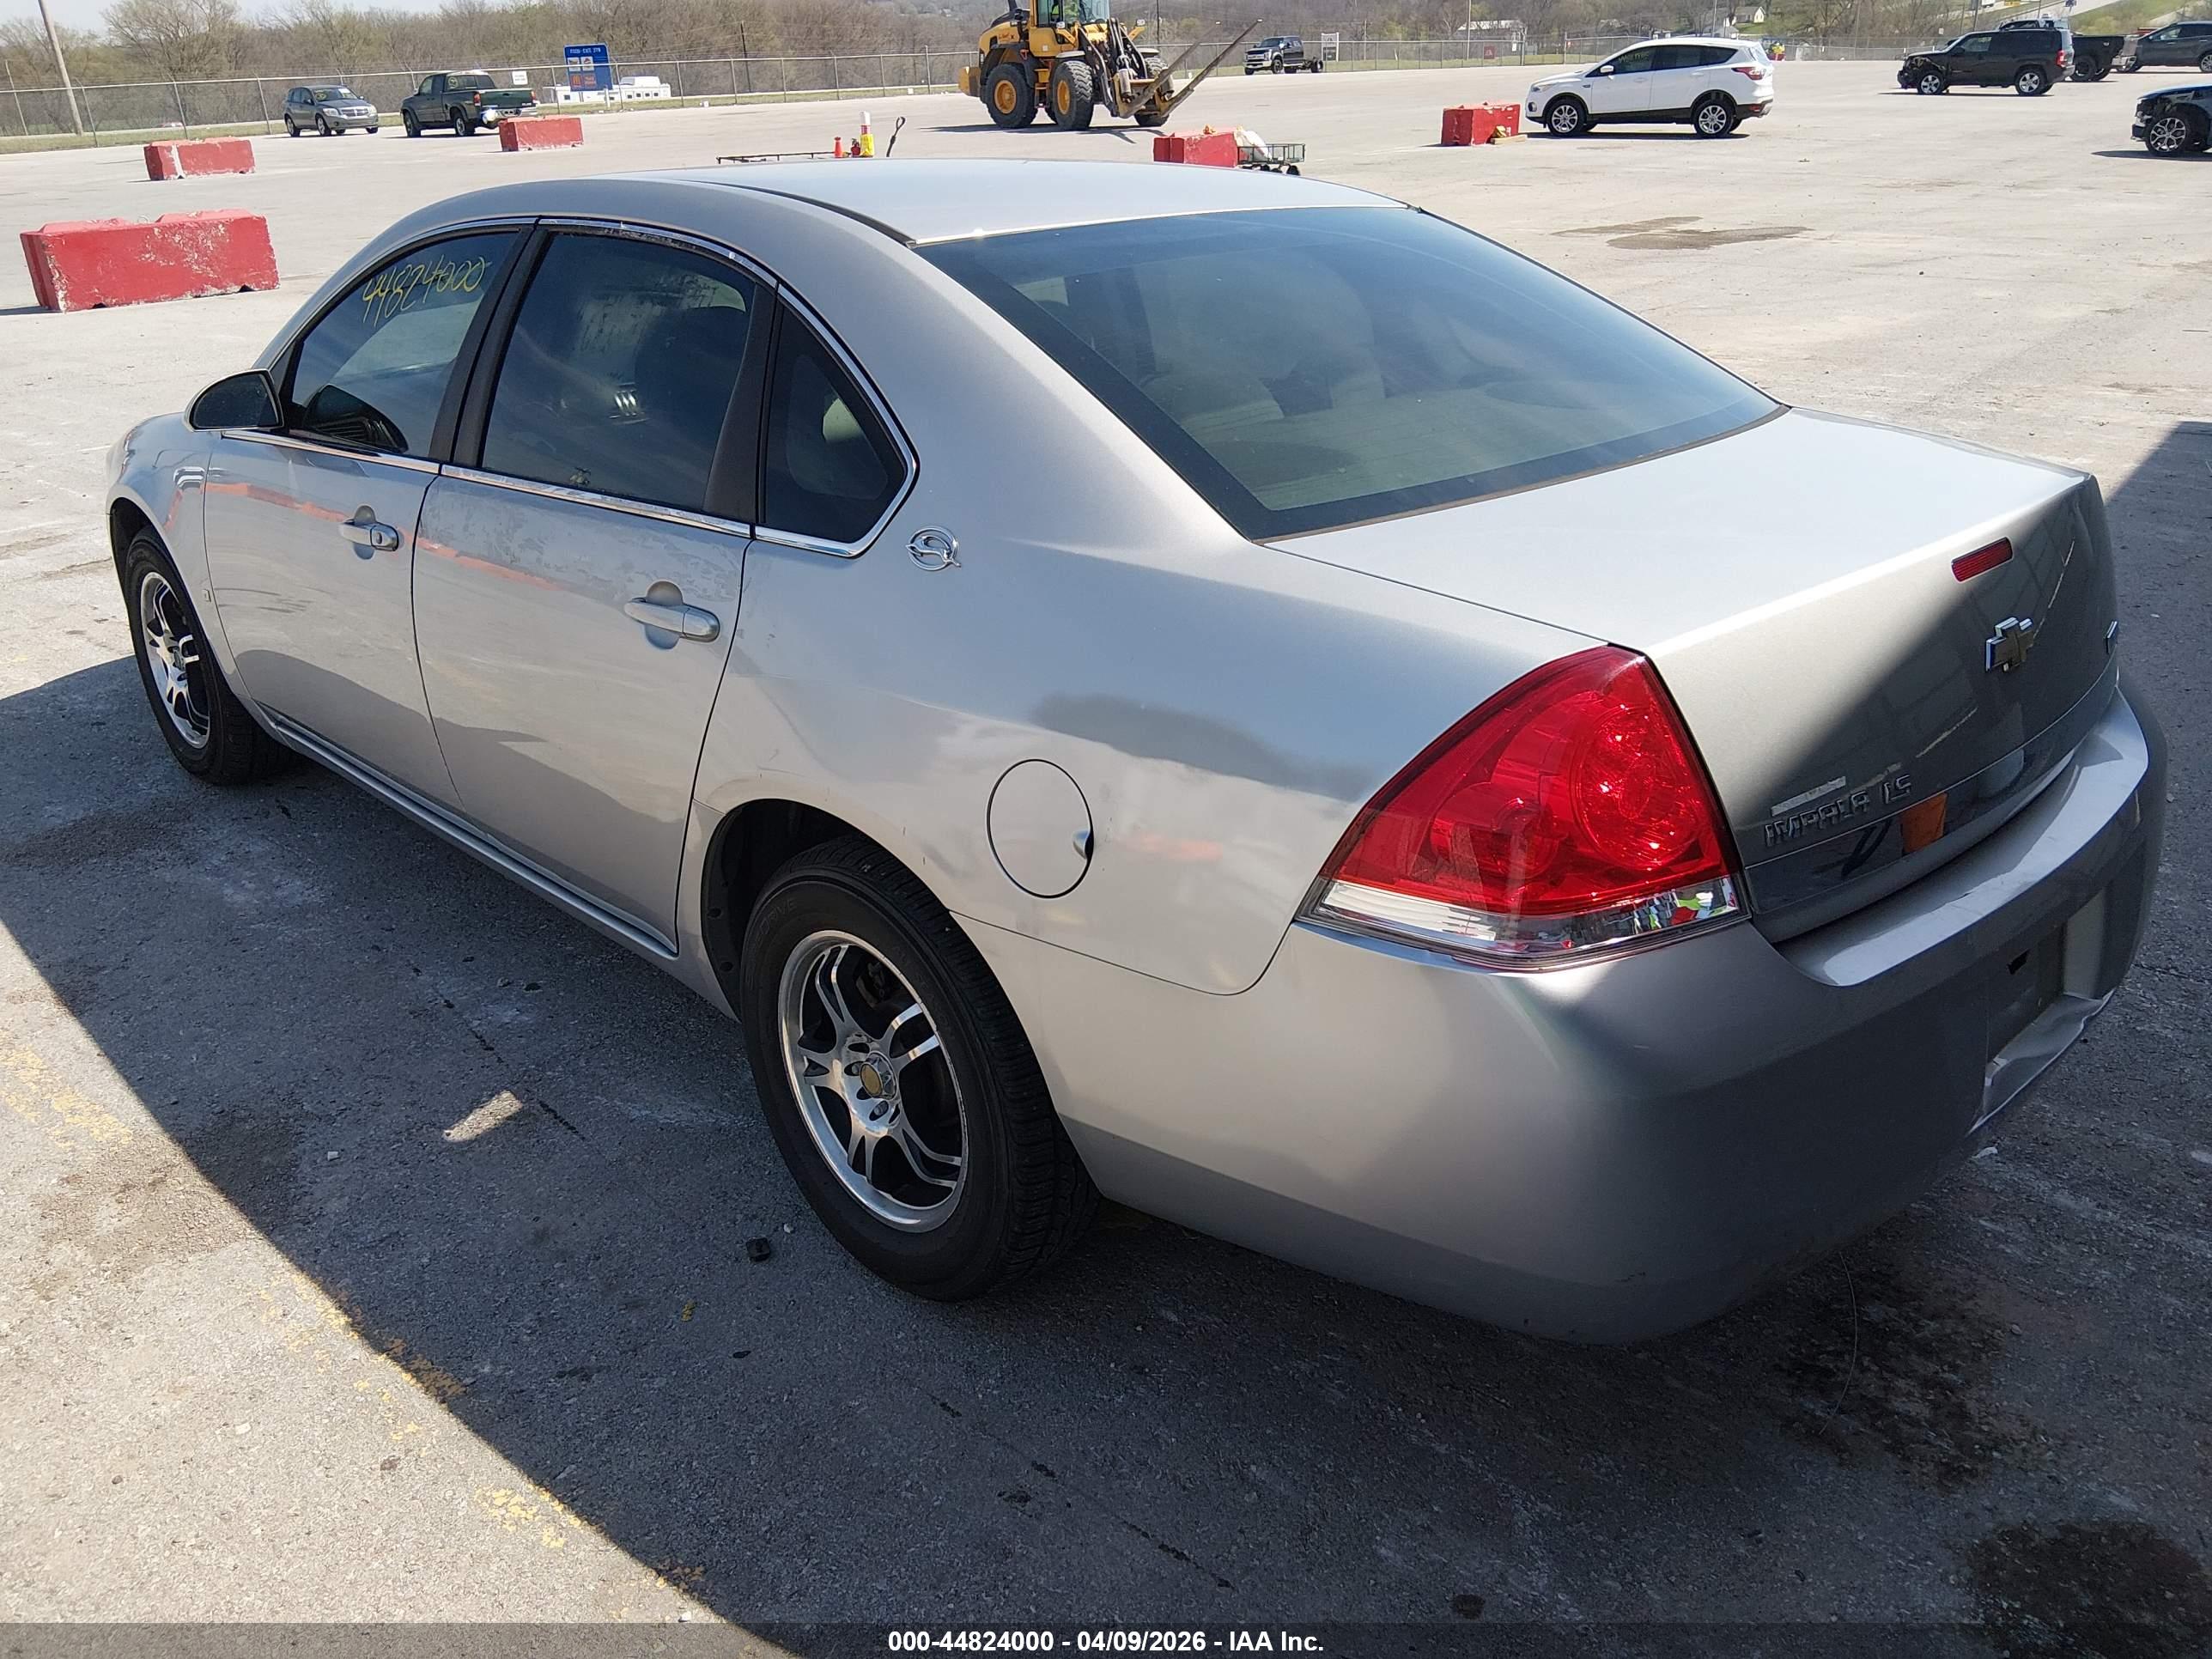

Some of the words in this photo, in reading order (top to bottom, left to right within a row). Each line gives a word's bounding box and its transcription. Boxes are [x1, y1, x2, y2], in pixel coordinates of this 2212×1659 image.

[362, 254, 492, 327] 44824000
[1765, 791, 1870, 847] IMPALA
[1882, 775, 1911, 804] LS
